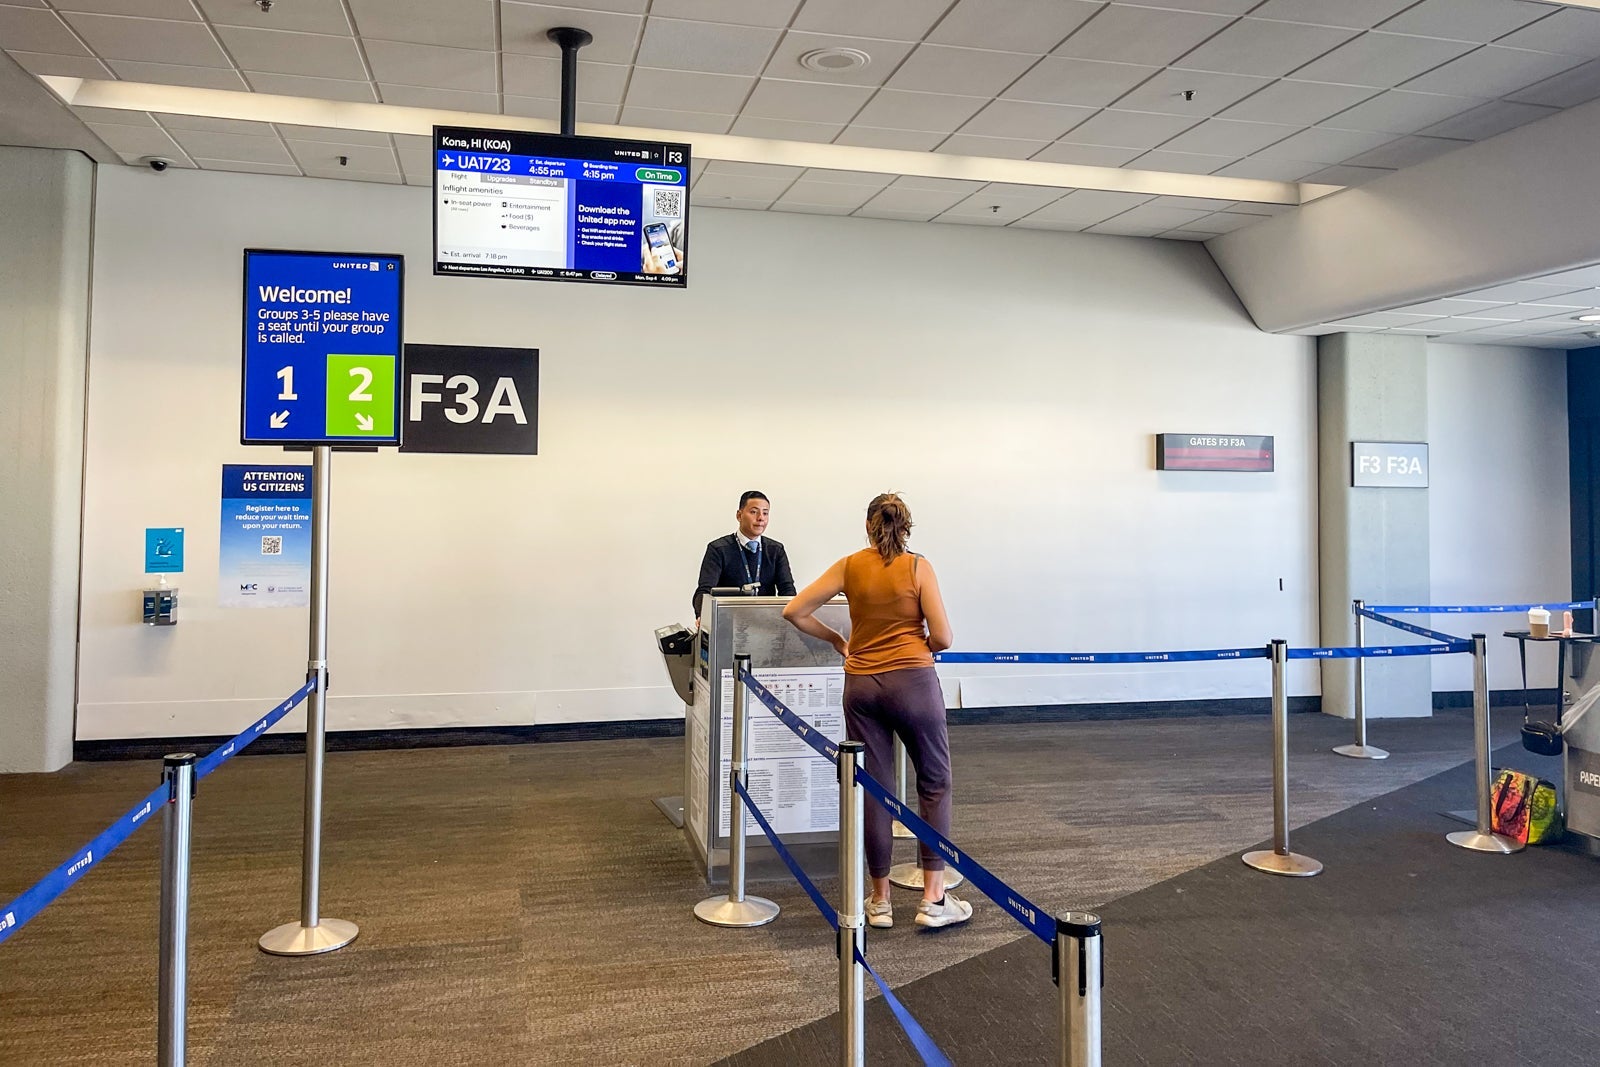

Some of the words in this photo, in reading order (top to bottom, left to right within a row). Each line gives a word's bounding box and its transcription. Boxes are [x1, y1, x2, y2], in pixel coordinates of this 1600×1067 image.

[442, 136, 469, 149] Kona,
[471, 138, 481, 149] HI
[483, 139, 511, 152] (KOA)
[668, 151, 683, 163] F3
[458, 155, 511, 172] UA1723
[451, 172, 468, 180] Flight
[529, 166, 549, 175] 4:55
[550, 168, 564, 177] pm
[583, 170, 600, 179] 4:15
[645, 171, 656, 179] On
[657, 172, 673, 181] Time
[487, 175, 516, 184] Upgrades
[529, 177, 558, 187] Standbys
[442, 184, 468, 193] Inflight
[468, 186, 504, 195] amenities
[451, 199, 472, 207] In-seat
[509, 203, 551, 212] Entertainment
[578, 204, 616, 216] Download
[617, 207, 630, 216] the
[509, 213, 524, 221] Food
[578, 214, 603, 225] United
[604, 216, 618, 226] app
[509, 223, 541, 232] Beverages
[333, 262, 368, 270] UNITED
[259, 286, 351, 304] Welcome!
[258, 309, 299, 321] Groups
[301, 310, 321, 320] 3-5
[323, 311, 360, 322] please
[362, 311, 390, 322] have
[258, 323, 265, 331] a
[268, 322, 292, 332] seat
[294, 322, 319, 332] until
[322, 325, 349, 334] your
[351, 325, 384, 335] group
[258, 333, 267, 343] is
[270, 333, 305, 344] called.
[276, 366, 298, 401] 1
[348, 367, 373, 402] 2
[409, 373, 528, 425] F3A
[1190, 437, 1217, 446] GATES
[1219, 438, 1229, 446] F3
[1230, 438, 1246, 447] F3A
[1360, 456, 1381, 474] F3
[1387, 456, 1423, 475] F3A
[243, 472, 305, 481] ATTENTION:
[243, 483, 257, 492] US
[259, 483, 305, 492] CITIZENS
[242, 523, 261, 531] upon
[261, 523, 278, 531] your
[1580, 770, 1600, 788] PAPE
[938, 840, 955, 858] UNITED
[67, 857, 88, 876] UNITED
[1007, 897, 1029, 916] UNITED
